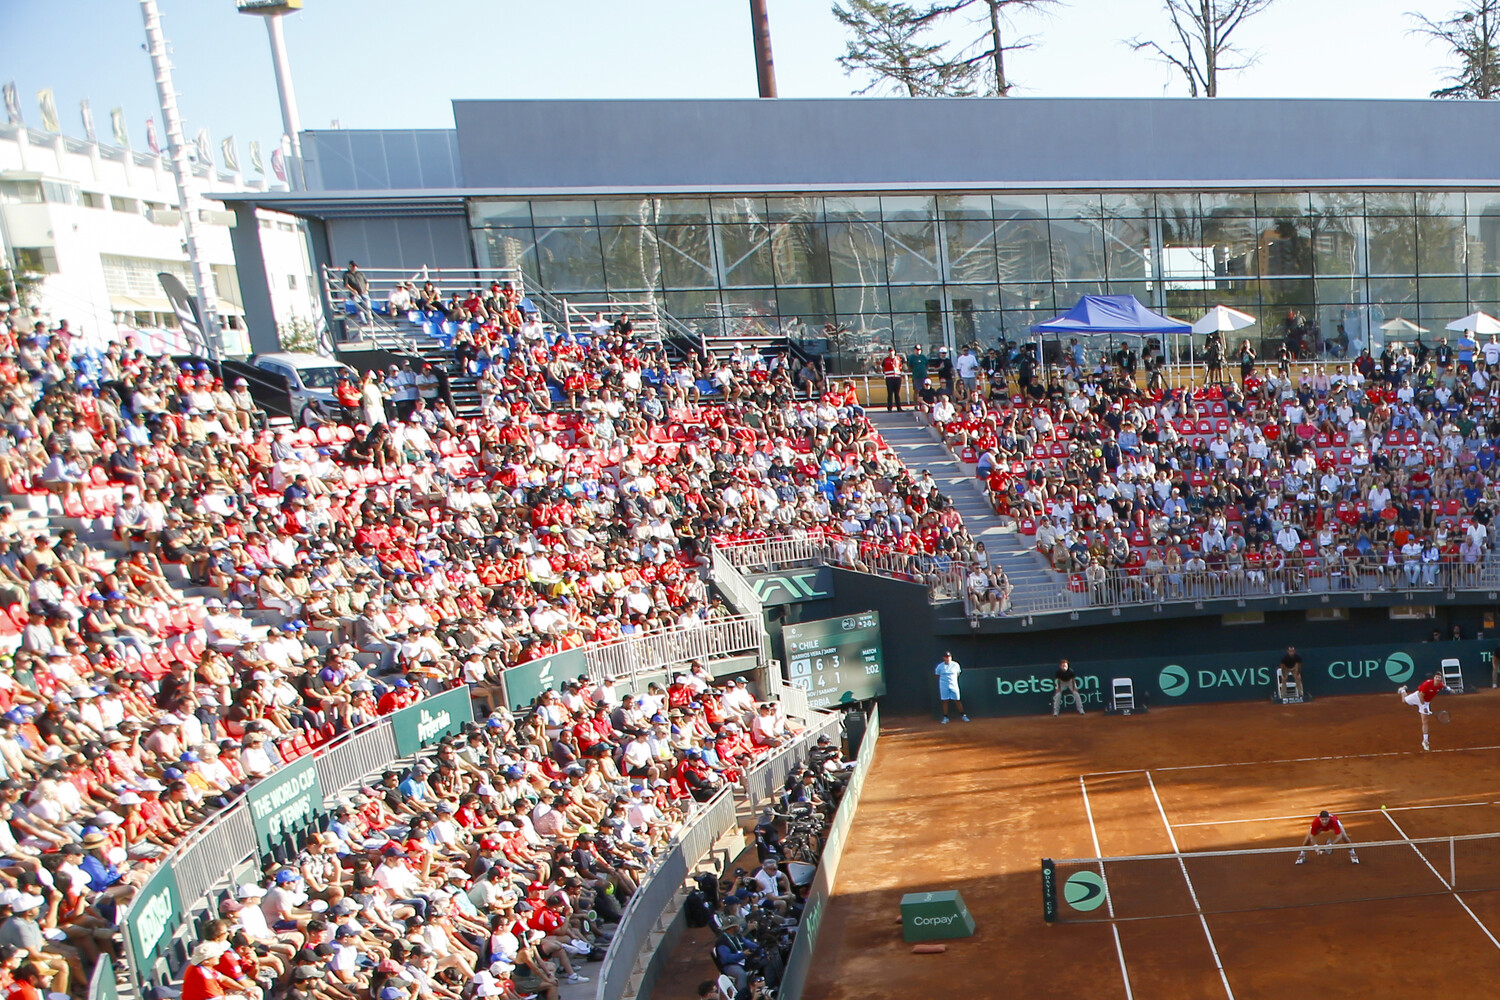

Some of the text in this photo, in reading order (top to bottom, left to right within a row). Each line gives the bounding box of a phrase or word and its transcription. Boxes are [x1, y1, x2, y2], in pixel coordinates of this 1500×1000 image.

[799, 640, 819, 651] CHILE
[862, 648, 877, 656] MATCH
[797, 655, 840, 674] 0 6 3
[864, 664, 879, 675] 1:02
[1328, 660, 1379, 680] CUP
[817, 675, 825, 687] 4
[835, 671, 840, 684] 1
[1198, 667, 1271, 689] DAVIS
[253, 767, 316, 819] THE WORLD CUP
[268, 814, 283, 836] OF
